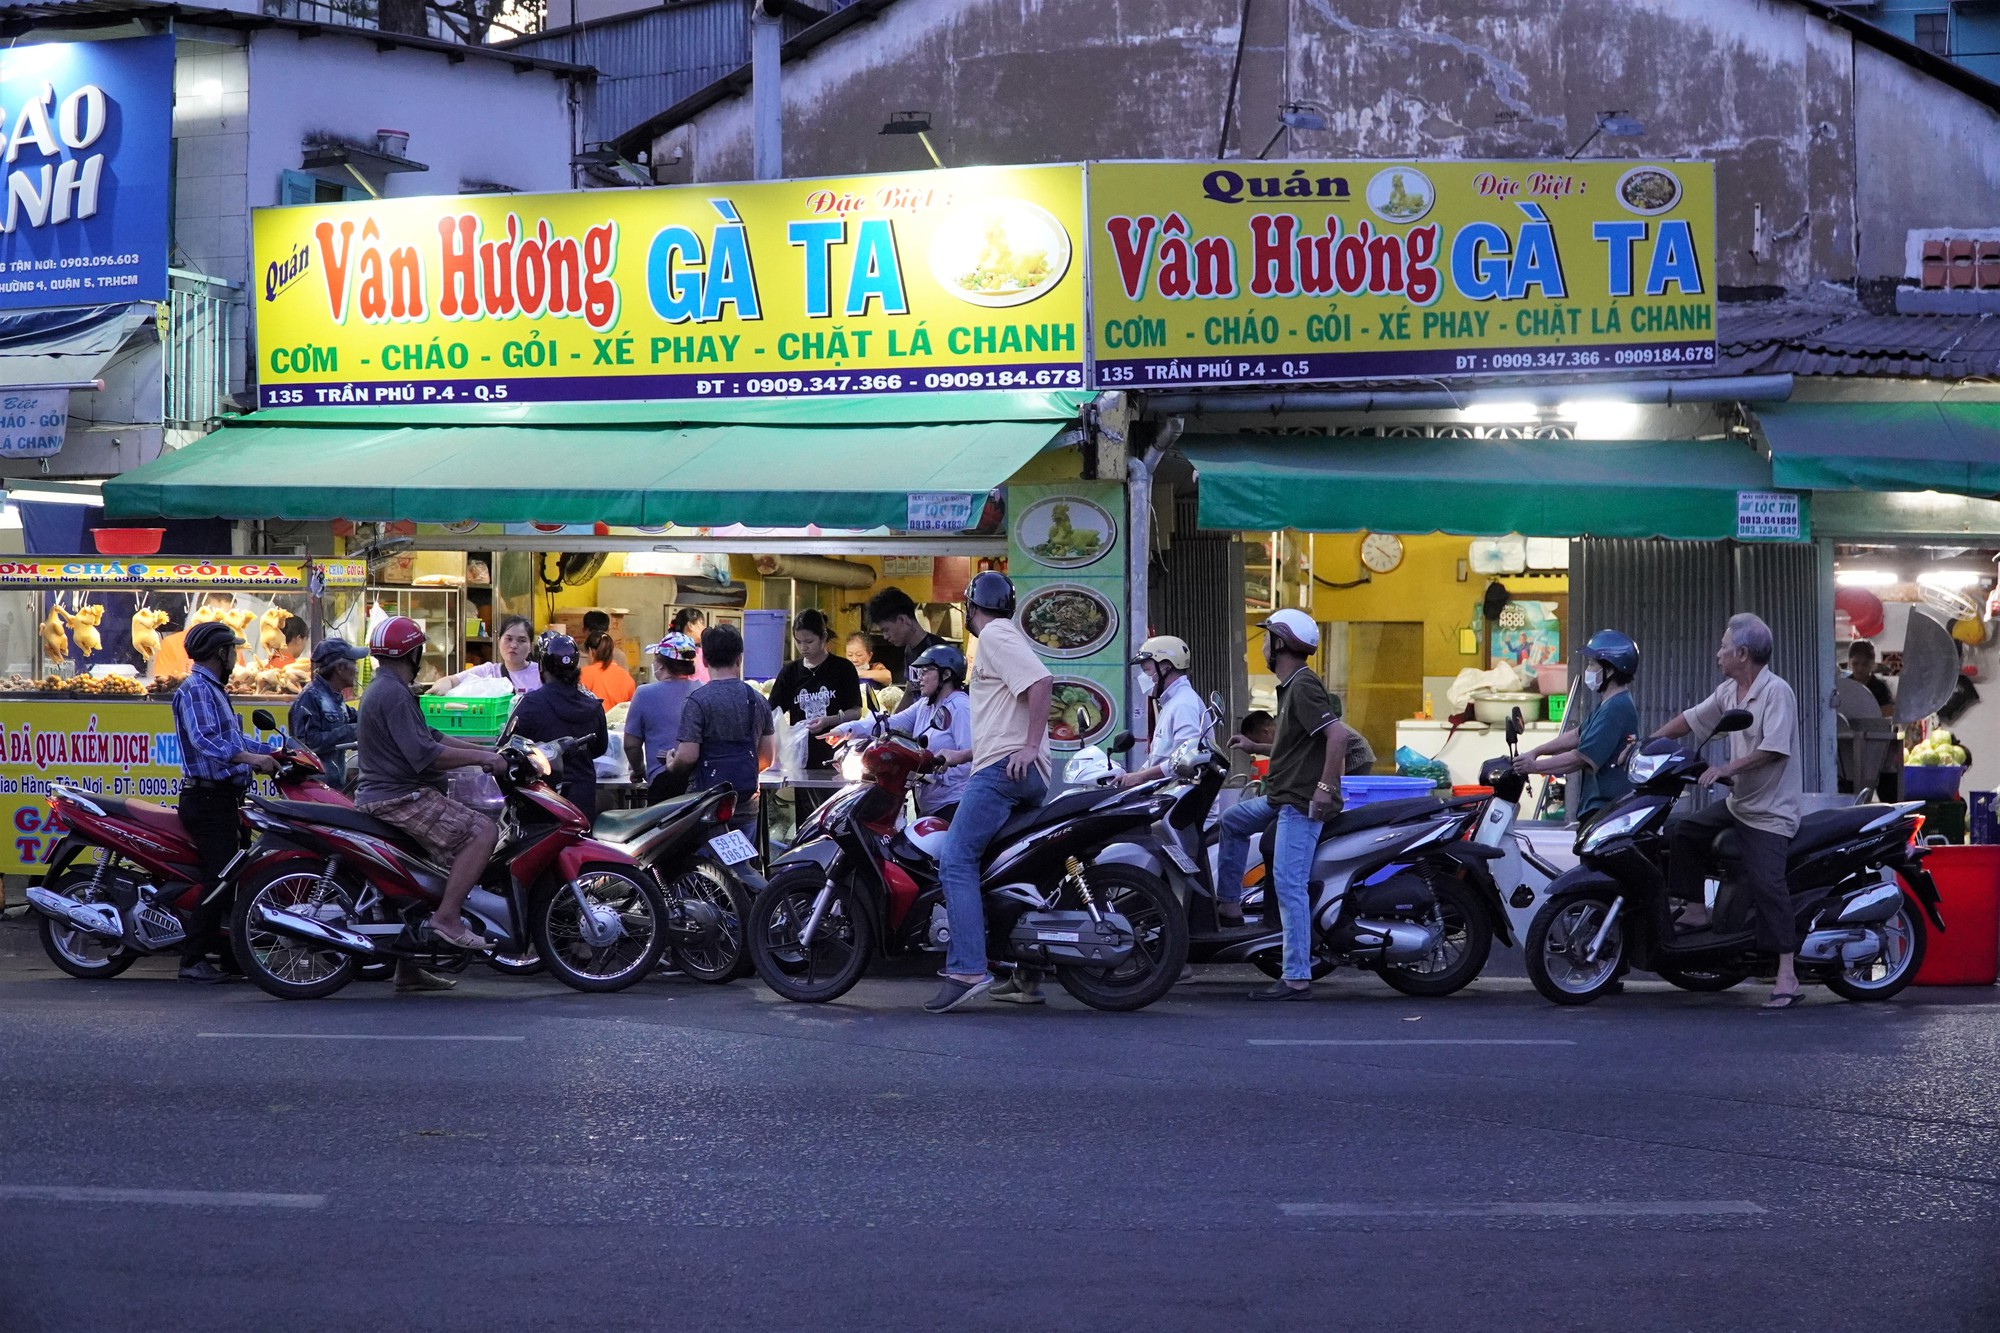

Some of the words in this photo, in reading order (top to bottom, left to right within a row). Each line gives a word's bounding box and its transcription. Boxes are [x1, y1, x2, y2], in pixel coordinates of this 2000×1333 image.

[0, 153, 104, 233] NH
[806, 189, 866, 218] Đặc
[874, 186, 936, 213] Biệt
[1202, 169, 1351, 204] Quán
[1473, 172, 1520, 200] Đặc
[1526, 172, 1573, 200] Biệt
[10, 260, 31, 274] TẬN
[60, 254, 139, 269] 0903.096.603
[314, 214, 428, 325] Vân
[438, 211, 618, 331] Hương
[647, 198, 763, 324] GÀ
[787, 217, 909, 316] TA
[1106, 211, 1239, 301] Vân
[1250, 213, 1441, 306] Hương
[1451, 201, 1567, 301] GÀ
[1592, 220, 1704, 296] TA
[36, 280, 47, 292] 4,
[51, 278, 80, 291] QUẬN
[84, 277, 95, 289] 5,
[265, 243, 311, 302] Quán
[1104, 315, 1166, 348] CƠM
[1204, 309, 1279, 345] CHÁO
[1307, 303, 1351, 342] GỎI
[1378, 304, 1411, 340] XÉ
[1423, 310, 1490, 339] PHAY
[1516, 303, 1582, 343] CHẶT
[1591, 300, 1622, 334] LÁ
[1631, 303, 1711, 332] CHANH
[270, 343, 338, 374] CƠM
[381, 336, 469, 370] CHÁO
[502, 330, 557, 367] GỎI
[593, 330, 635, 365] XÉ
[651, 334, 741, 364] PHAY
[777, 325, 872, 367] CHẶT
[888, 320, 933, 357] LÁ
[948, 322, 1076, 355] CHANH
[1101, 366, 1134, 382] 135
[1145, 359, 1192, 380] TRẦN
[1198, 359, 1232, 378] PHÚ
[1239, 362, 1265, 377] P.4
[1282, 360, 1310, 376] Q.5
[1456, 355, 1477, 369] ĐT
[1492, 351, 1600, 368] 0909.347.366
[1614, 346, 1714, 364] 0909184.678
[268, 389, 304, 404] 135
[315, 382, 369, 402] TRẦN
[375, 382, 416, 401] PHÚ
[423, 385, 454, 400] P.4
[474, 384, 508, 400] Q.5
[696, 379, 725, 395] ĐT
[746, 374, 902, 394] 0909.347.366
[924, 369, 1082, 389] 0909184.678
[4, 397, 38, 412] Biệt
[2, 575, 31, 583] Hàng
[114, 576, 199, 584] 0909.347.366
[212, 577, 298, 585] 0909.184.678
[62, 561, 149, 575] CHÁO
[173, 561, 231, 576] GỎI
[239, 562, 284, 576] GÀ
[1499, 619, 1525, 627] MOOD
[1500, 612, 1525, 620] GOOD
[794, 690, 837, 704] LIFEWORK
[11, 724, 32, 762] ĐÃ
[36, 732, 68, 769] QUA
[71, 715, 109, 763] KIỂM
[112, 734, 149, 771] DỊCH
[21, 776, 52, 797] Hàng
[114, 778, 135, 795] ĐT:
